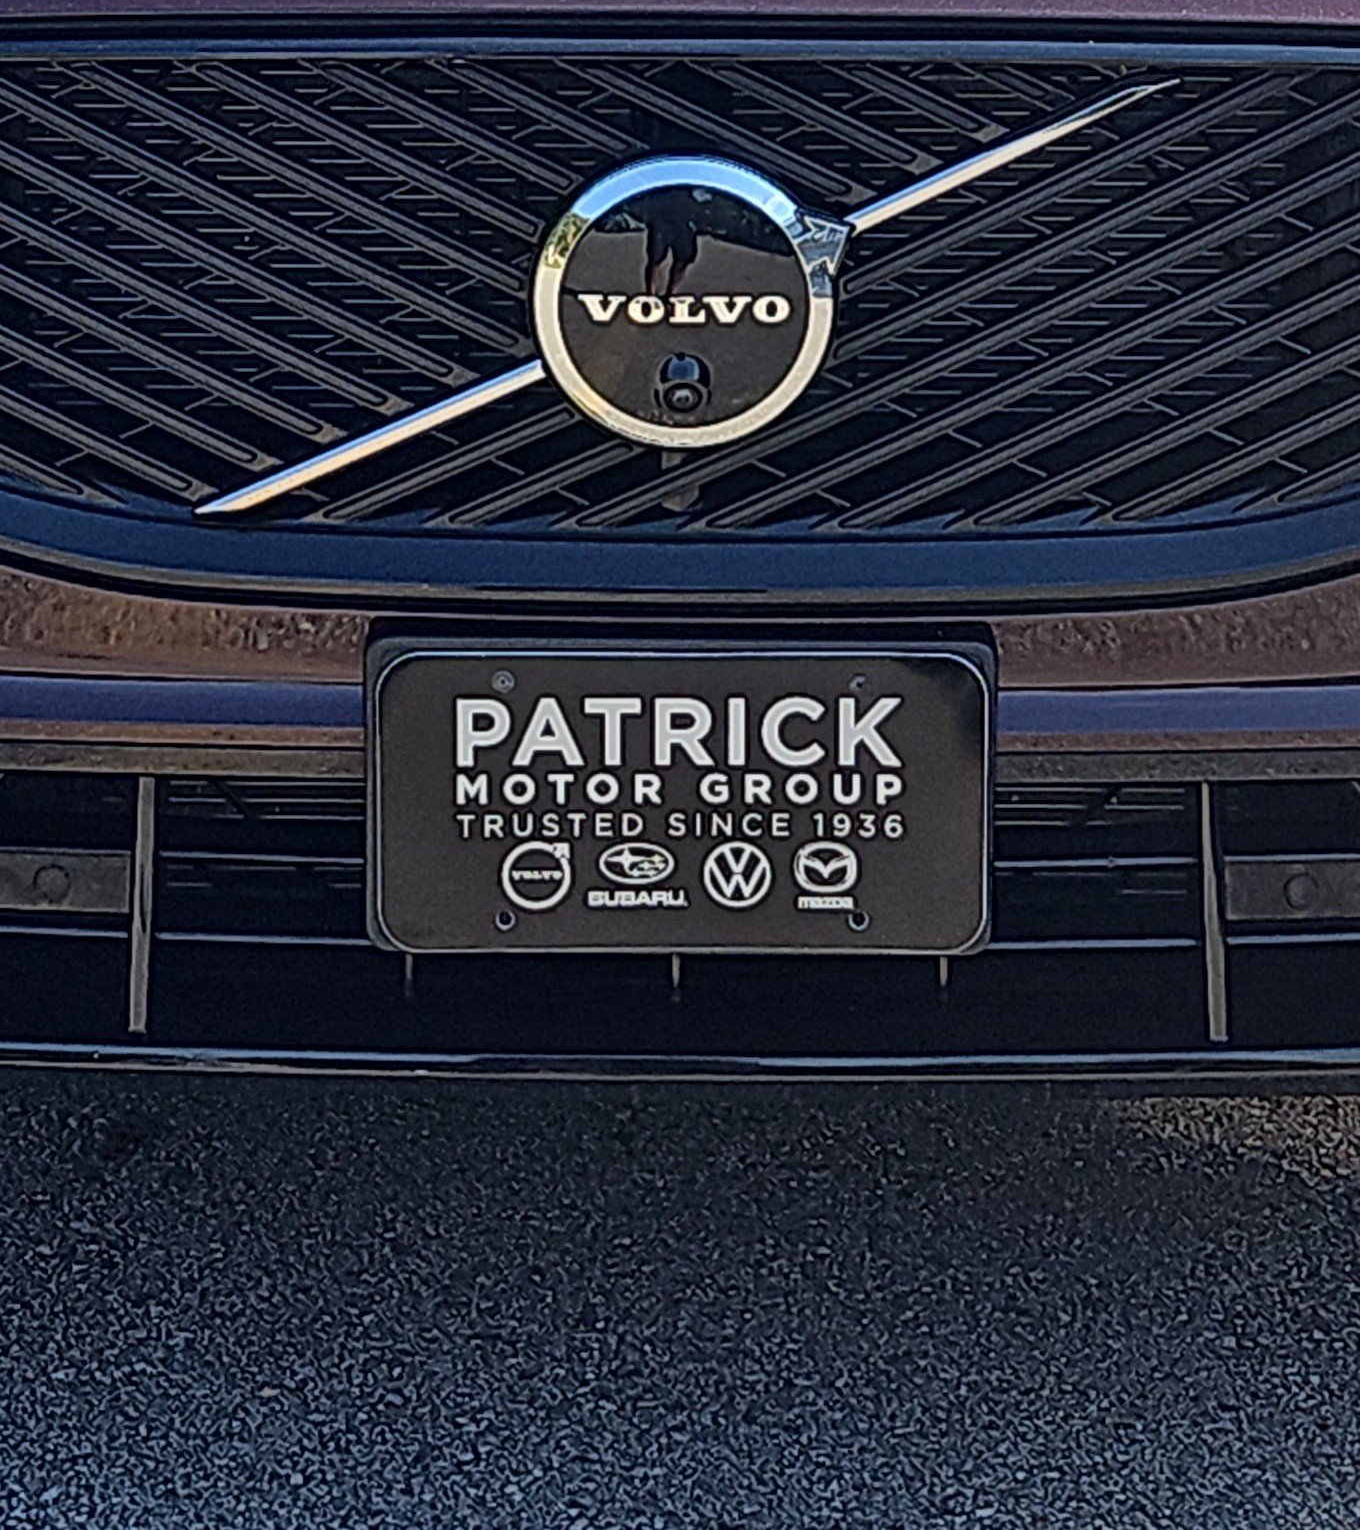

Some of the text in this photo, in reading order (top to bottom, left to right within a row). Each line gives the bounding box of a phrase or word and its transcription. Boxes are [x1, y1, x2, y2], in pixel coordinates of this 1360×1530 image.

[578, 295, 791, 324] VOLVO
[455, 696, 903, 768] PATRICK
[456, 772, 903, 806] MOTOR GROUP
[456, 812, 904, 839] TRUSTED SINCE 1936
[587, 890, 685, 907] SUBARU
